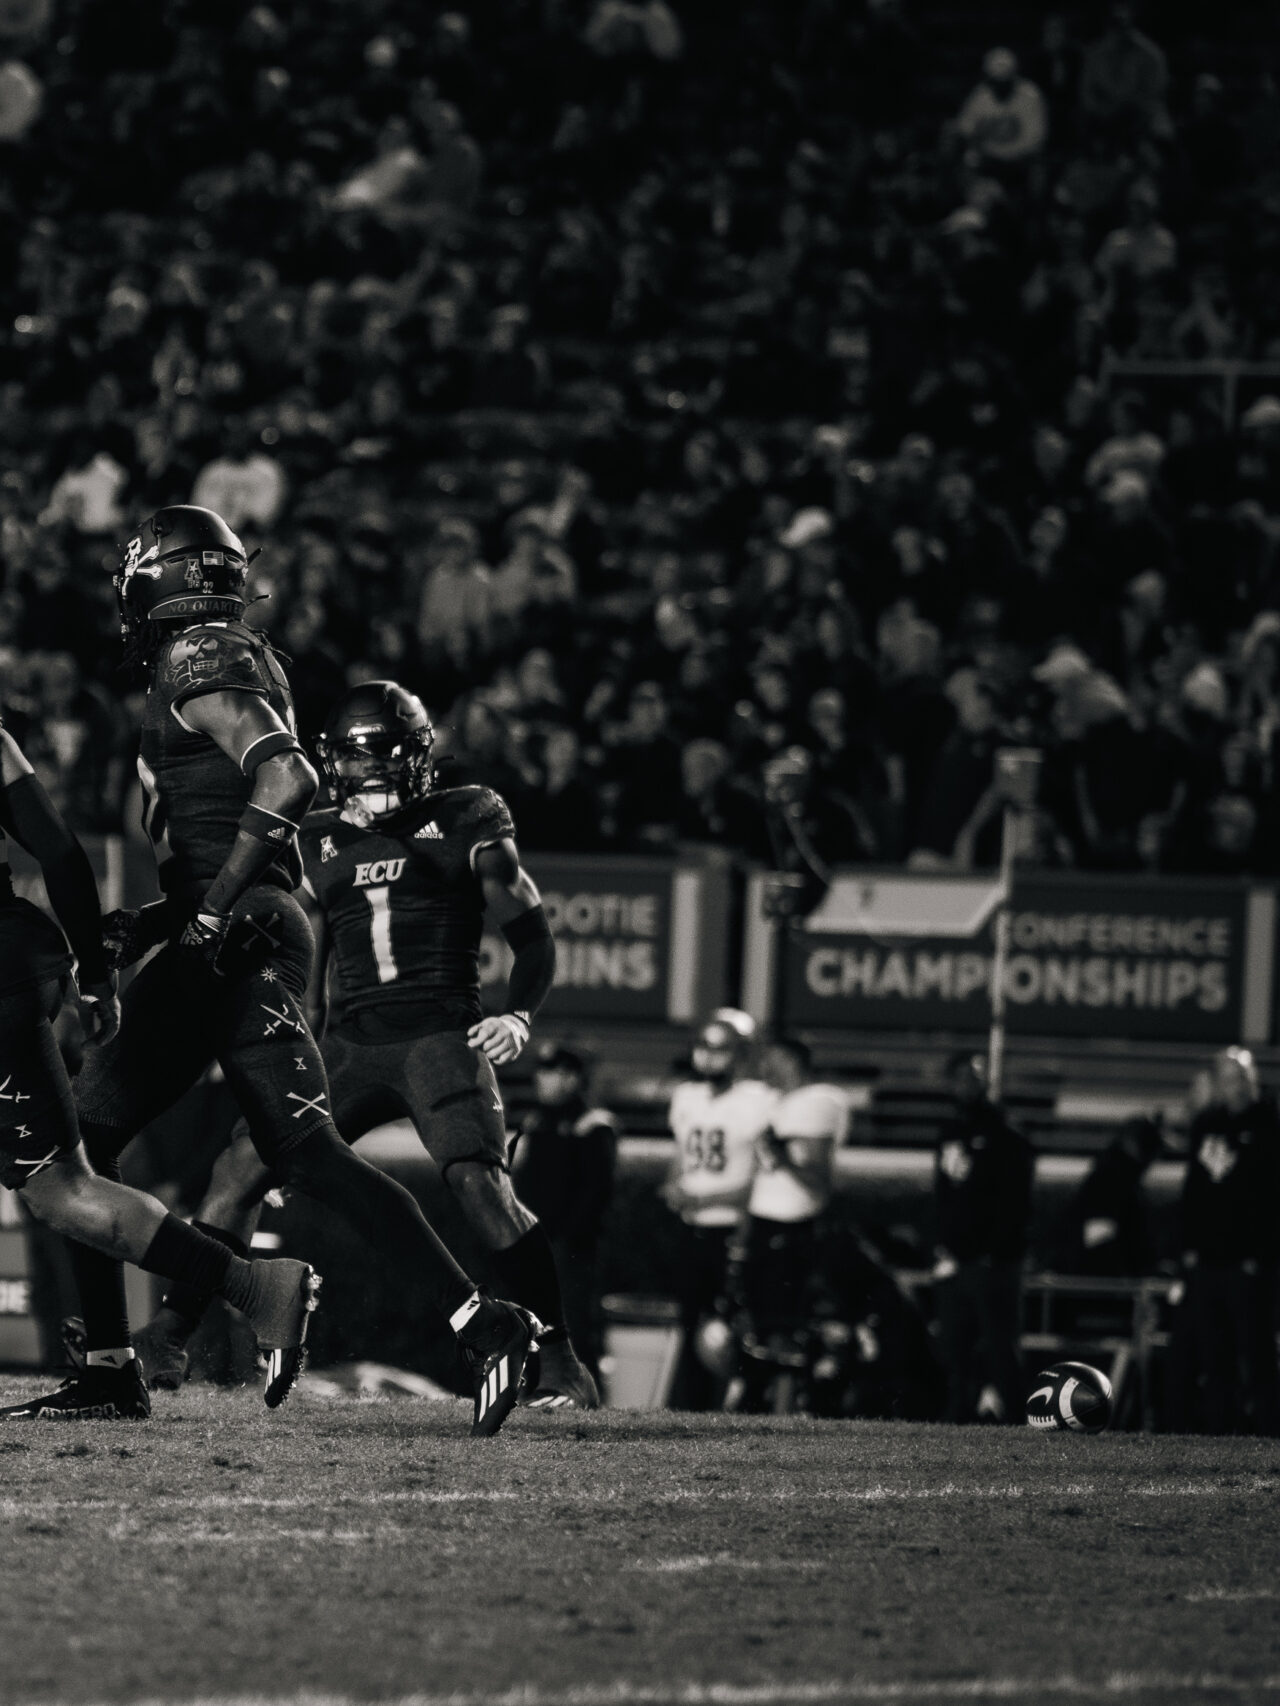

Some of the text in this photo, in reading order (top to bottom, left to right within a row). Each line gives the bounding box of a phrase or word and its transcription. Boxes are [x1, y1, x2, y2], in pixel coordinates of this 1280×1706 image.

[352, 857, 408, 887] ECU
[362, 885, 400, 985] 1
[804, 947, 1229, 1013] CHAMPONSHIPS
